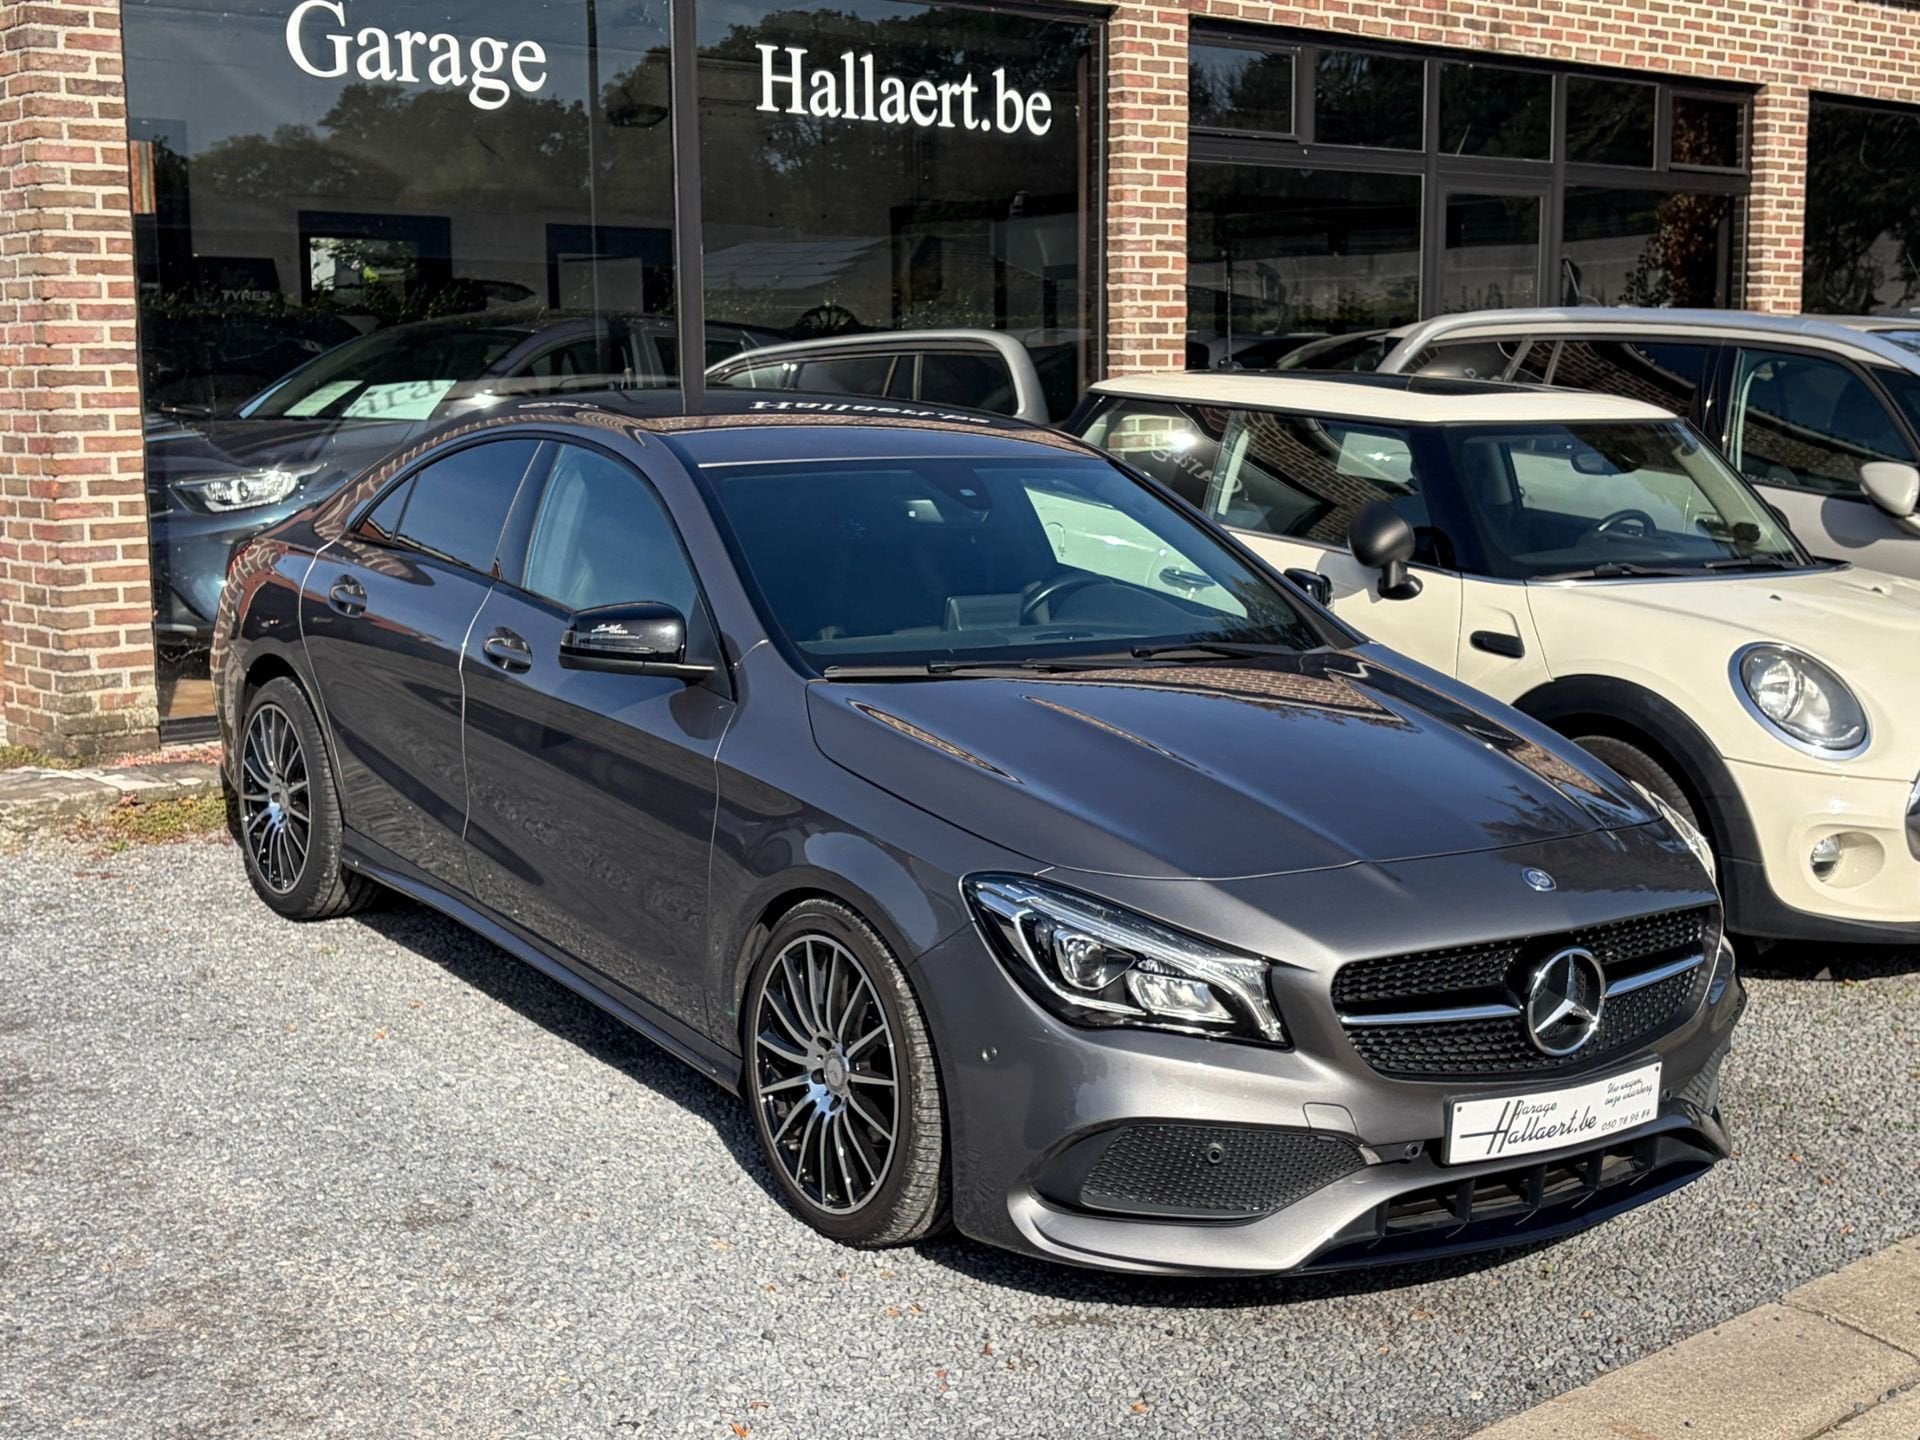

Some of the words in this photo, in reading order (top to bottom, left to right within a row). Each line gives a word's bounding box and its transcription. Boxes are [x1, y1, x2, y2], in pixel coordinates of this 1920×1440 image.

[286, 0, 547, 110] Garage
[756, 44, 1052, 136] Hallaert.be
[221, 289, 272, 302] TYRES
[1460, 1101, 1598, 1155] Hallaert.be
[1515, 1100, 1558, 1120] Garage
[1601, 1119, 1617, 1131] 050
